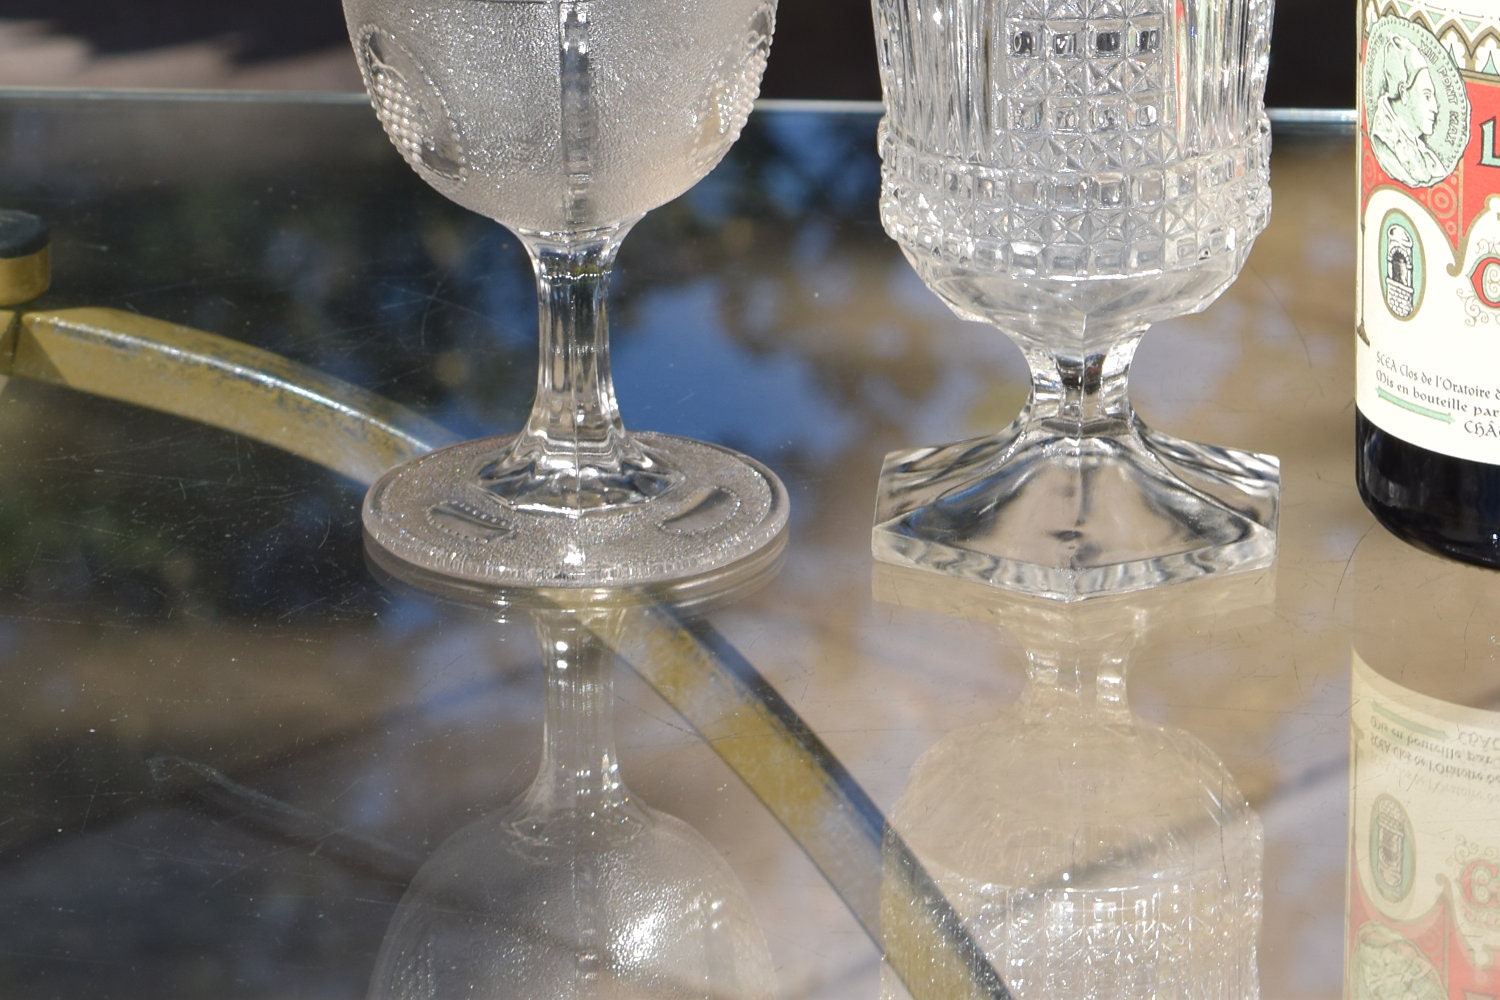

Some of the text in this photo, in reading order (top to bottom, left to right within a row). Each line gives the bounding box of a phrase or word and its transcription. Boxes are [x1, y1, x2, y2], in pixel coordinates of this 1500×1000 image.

[1437, 66, 1459, 105] PONT
[1444, 111, 1459, 146] MAX
[1376, 350, 1397, 373] SCEA
[1400, 364, 1418, 381] Clos
[1421, 372, 1432, 386] de
[1435, 375, 1490, 399] l'Oratoire
[1376, 369, 1394, 388] Mis
[1397, 384, 1409, 395] en
[1413, 386, 1468, 412] bouteille
[1473, 406, 1499, 418] par
